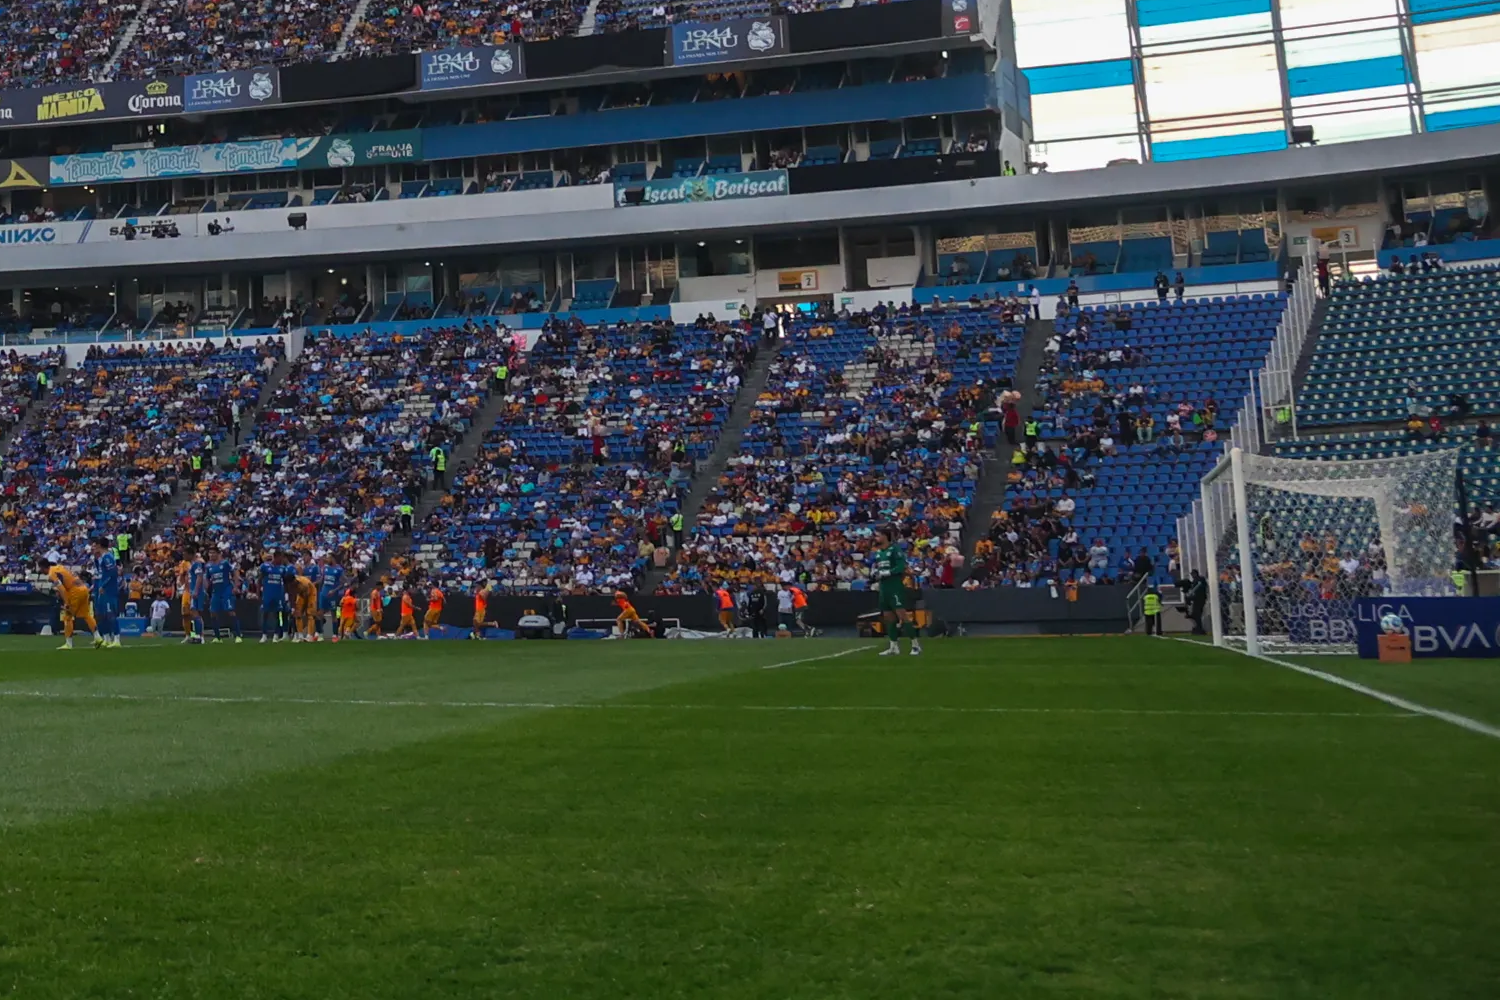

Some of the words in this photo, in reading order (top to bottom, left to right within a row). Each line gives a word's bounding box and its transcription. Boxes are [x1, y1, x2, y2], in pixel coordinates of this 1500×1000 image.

[686, 27, 732, 41] 1944
[682, 34, 738, 51] LFNU
[432, 51, 474, 65] 1944
[428, 58, 480, 75] LFNU
[196, 77, 236, 90] 1944
[192, 84, 241, 99] LFNU
[128, 94, 182, 113] Corona
[715, 175, 786, 199] Beriscat
[617, 185, 685, 206] Biscat
[1344, 233, 1350, 242] 3
[805, 277, 811, 287] 2
[1289, 603, 1327, 618] LIGA
[1403, 623, 1491, 651] BVA
